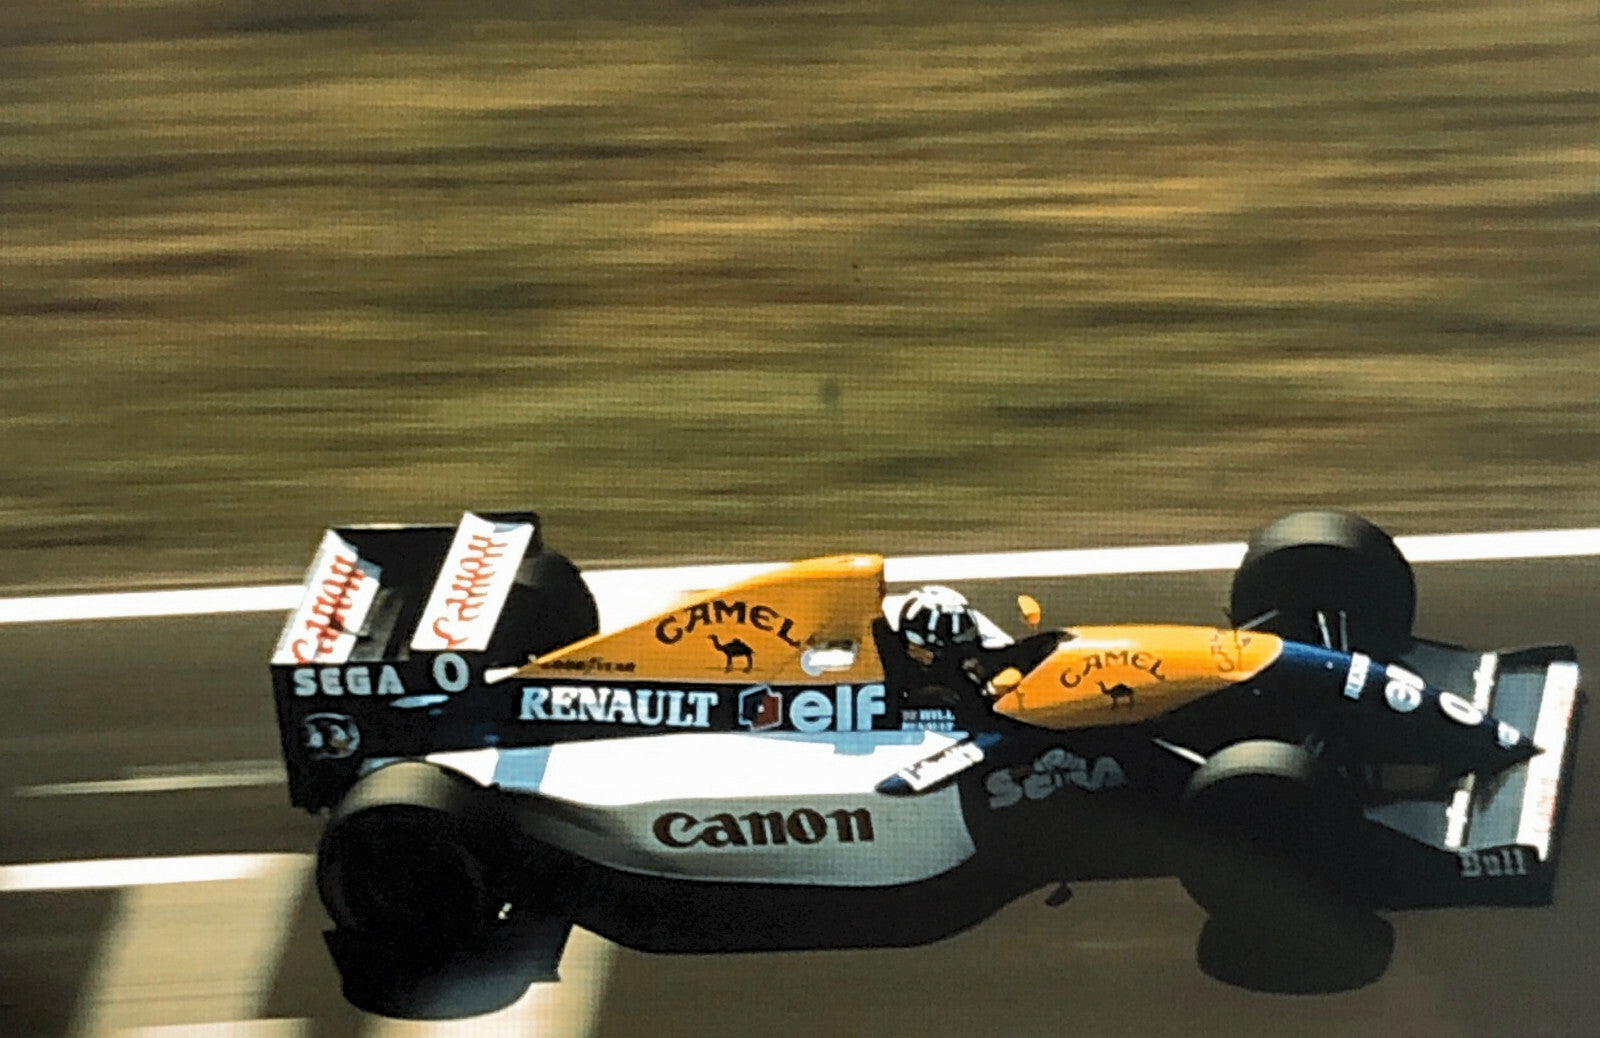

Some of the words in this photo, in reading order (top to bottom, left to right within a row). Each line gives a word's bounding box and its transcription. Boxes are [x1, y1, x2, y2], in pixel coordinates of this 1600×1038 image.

[655, 599, 801, 649] CAMEL
[293, 665, 405, 697] SEGA
[1059, 649, 1166, 689] CAMEL
[519, 687, 718, 728] RENAULT
[789, 684, 886, 731] elf
[653, 808, 875, 848] Canon
